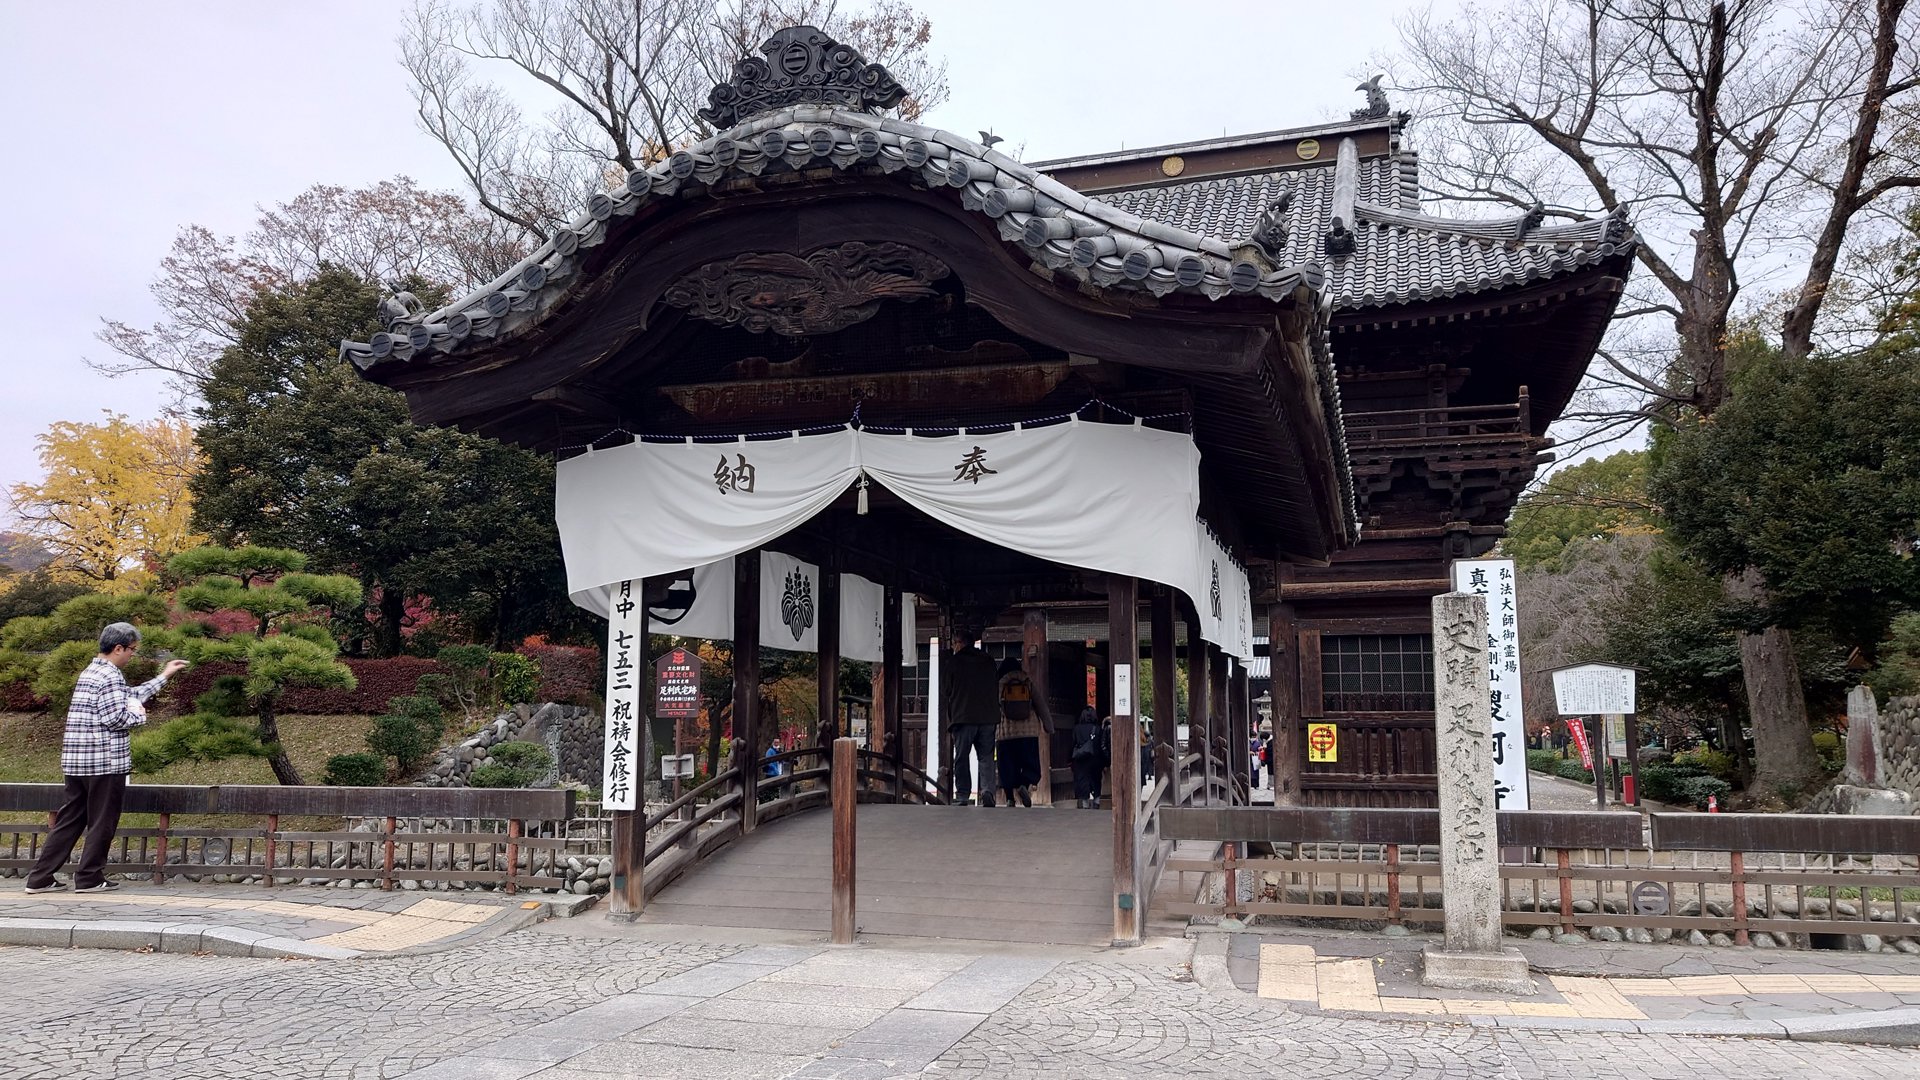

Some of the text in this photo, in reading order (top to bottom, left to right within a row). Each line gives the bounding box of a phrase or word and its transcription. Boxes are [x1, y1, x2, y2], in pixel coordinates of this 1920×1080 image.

[713, 445, 998, 495] 奉 納
[612, 629, 634, 691] 七五三
[1499, 567, 1518, 673] 弘法大師御霊場
[608, 698, 633, 804] 祝祷会修行
